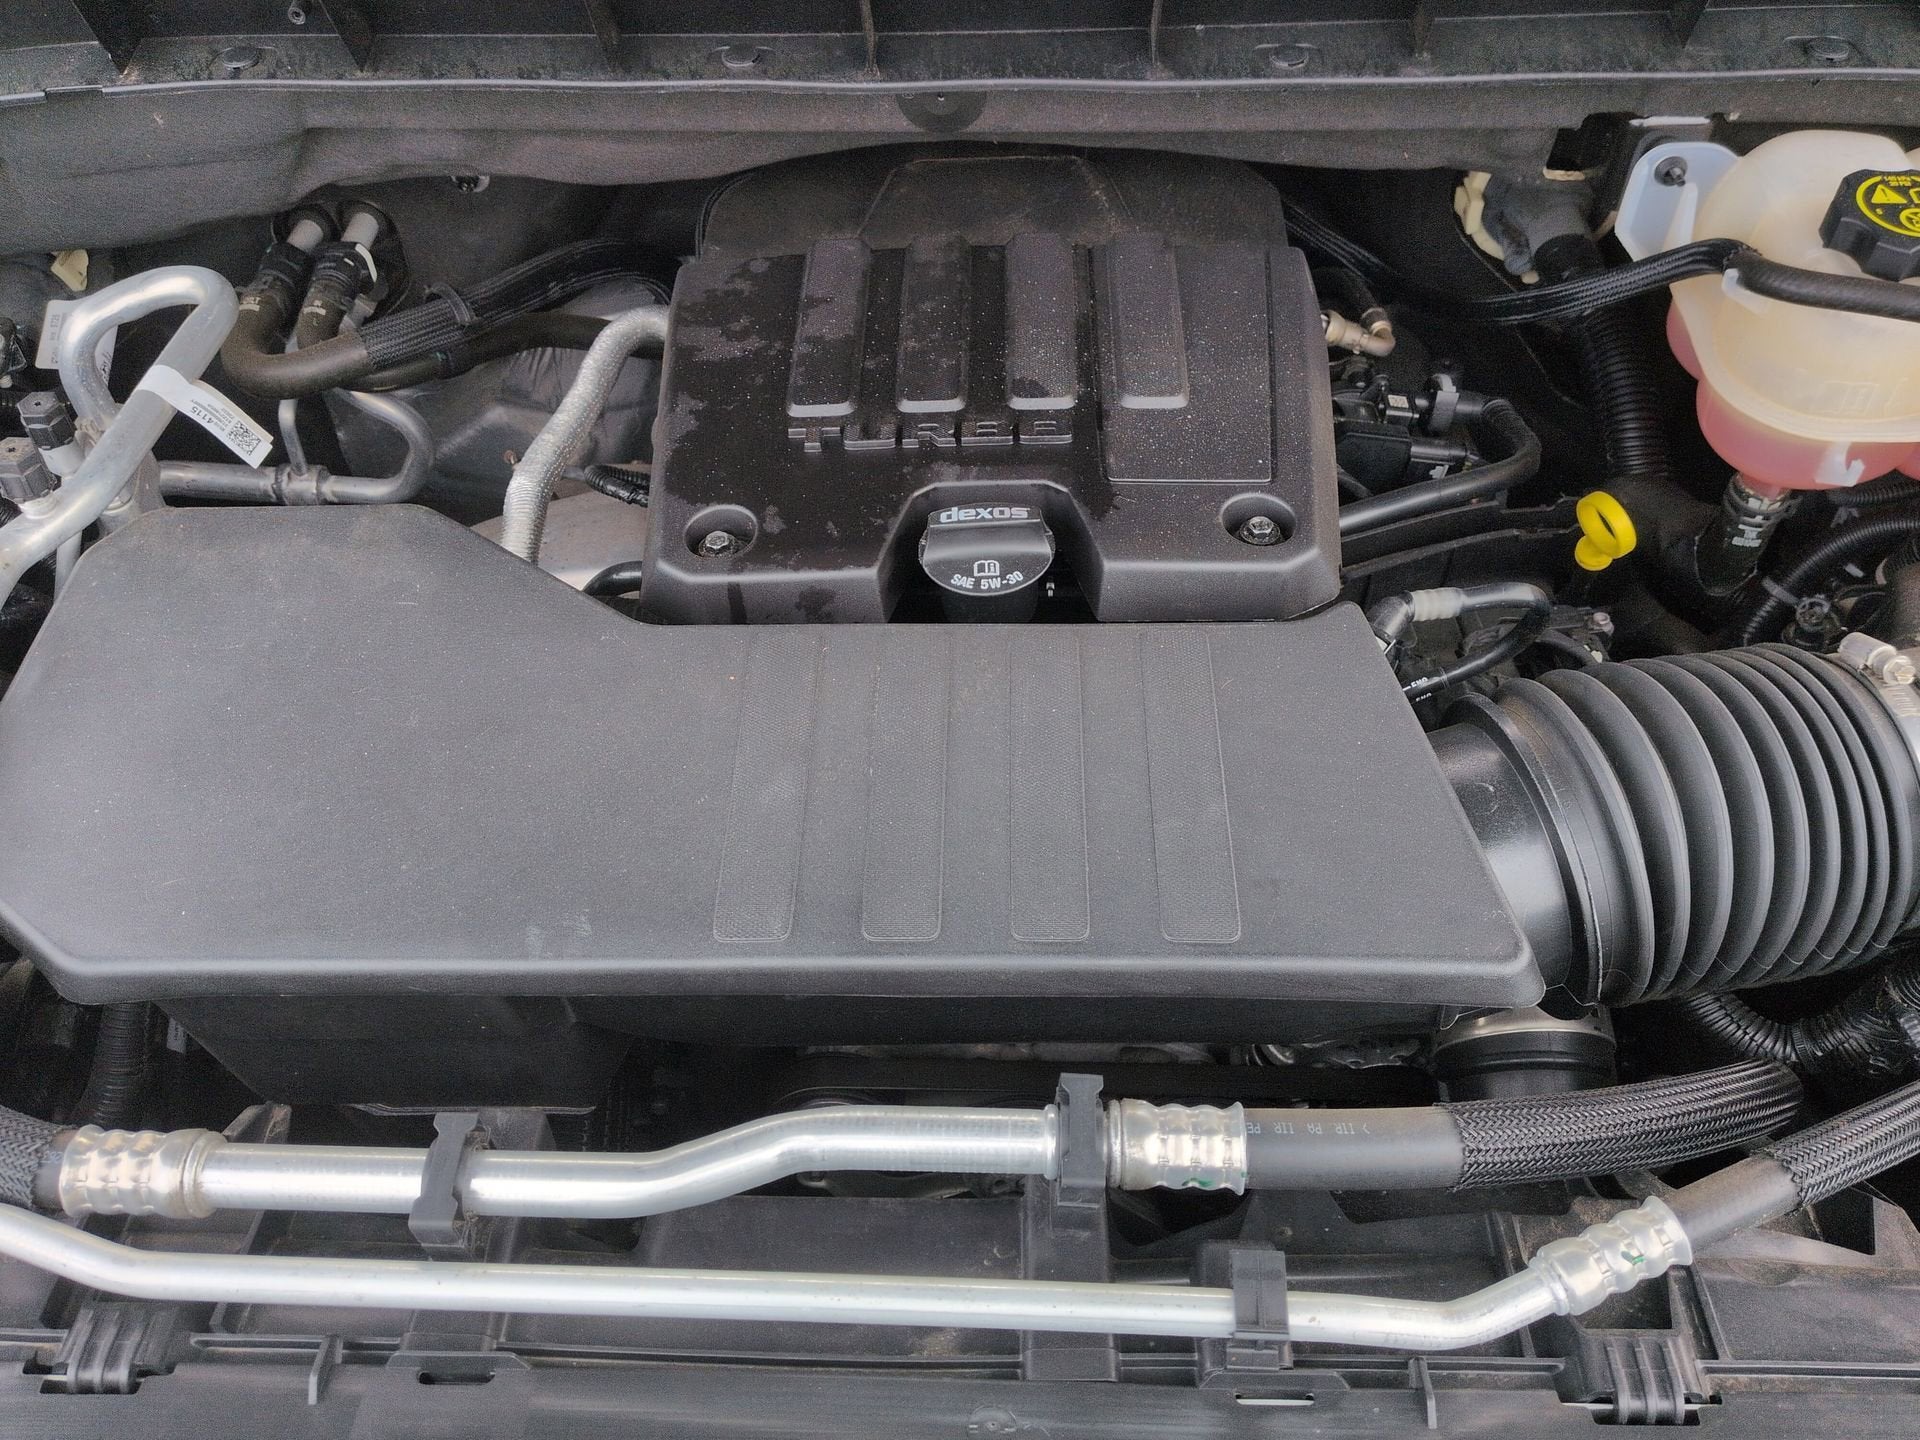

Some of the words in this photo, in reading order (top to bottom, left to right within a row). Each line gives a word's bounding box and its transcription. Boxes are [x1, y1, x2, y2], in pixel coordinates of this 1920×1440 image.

[191, 406, 214, 424] 4115
[940, 506, 1030, 523] dexos
[950, 573, 974, 590] SAE
[981, 571, 1024, 590] 5W-30
